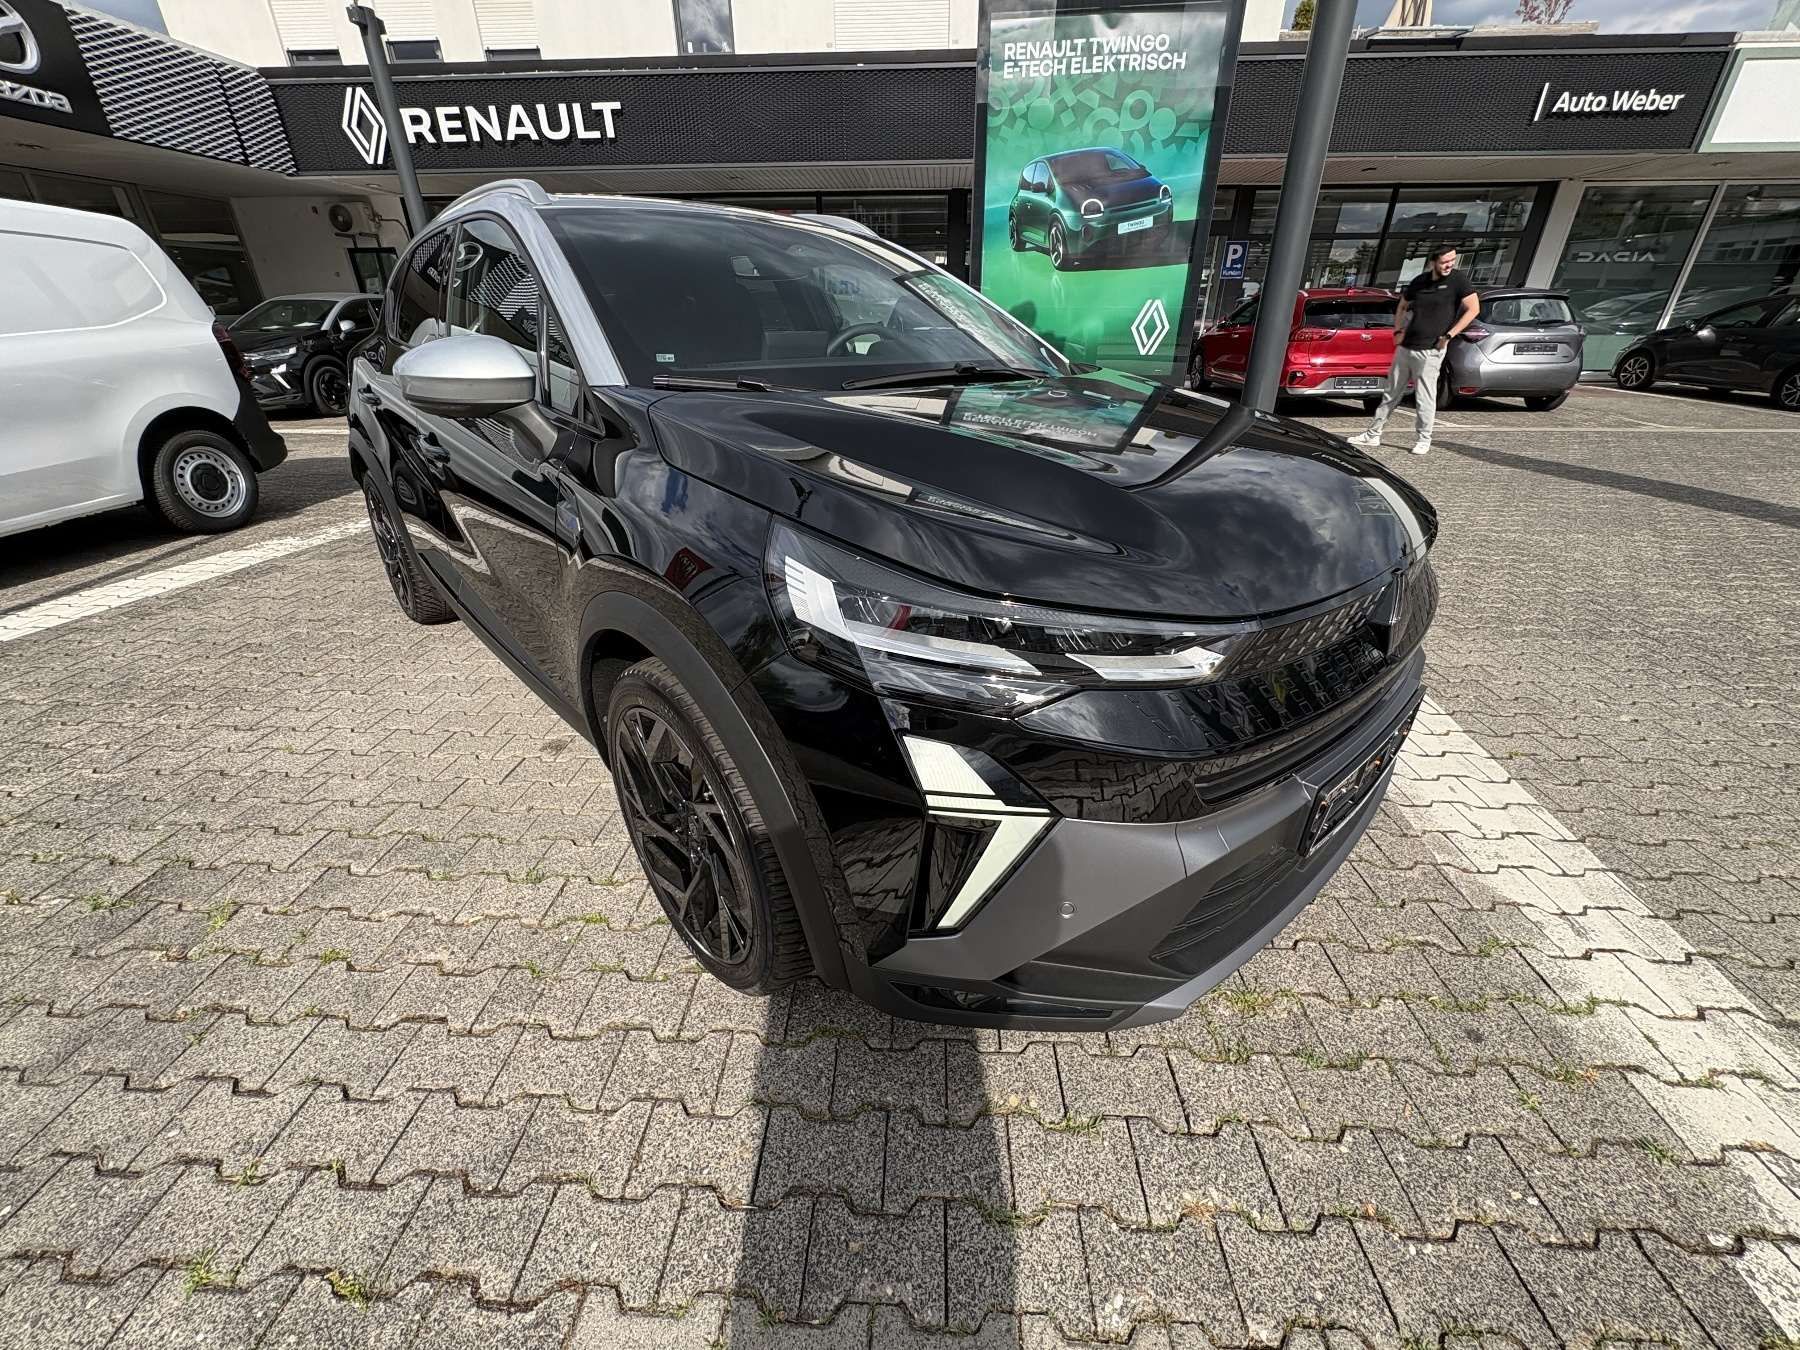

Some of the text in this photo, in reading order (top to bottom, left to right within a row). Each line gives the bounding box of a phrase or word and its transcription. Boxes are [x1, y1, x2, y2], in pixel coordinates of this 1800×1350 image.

[1004, 33, 1170, 60] RENAULT TWINGO
[1003, 52, 1187, 79] E-TECH ELEKTRISCH
[1552, 89, 1686, 112] Auto Weber
[399, 101, 622, 144] RENAULT
[1226, 244, 1243, 268] P
[1576, 251, 1656, 263] DACIA
